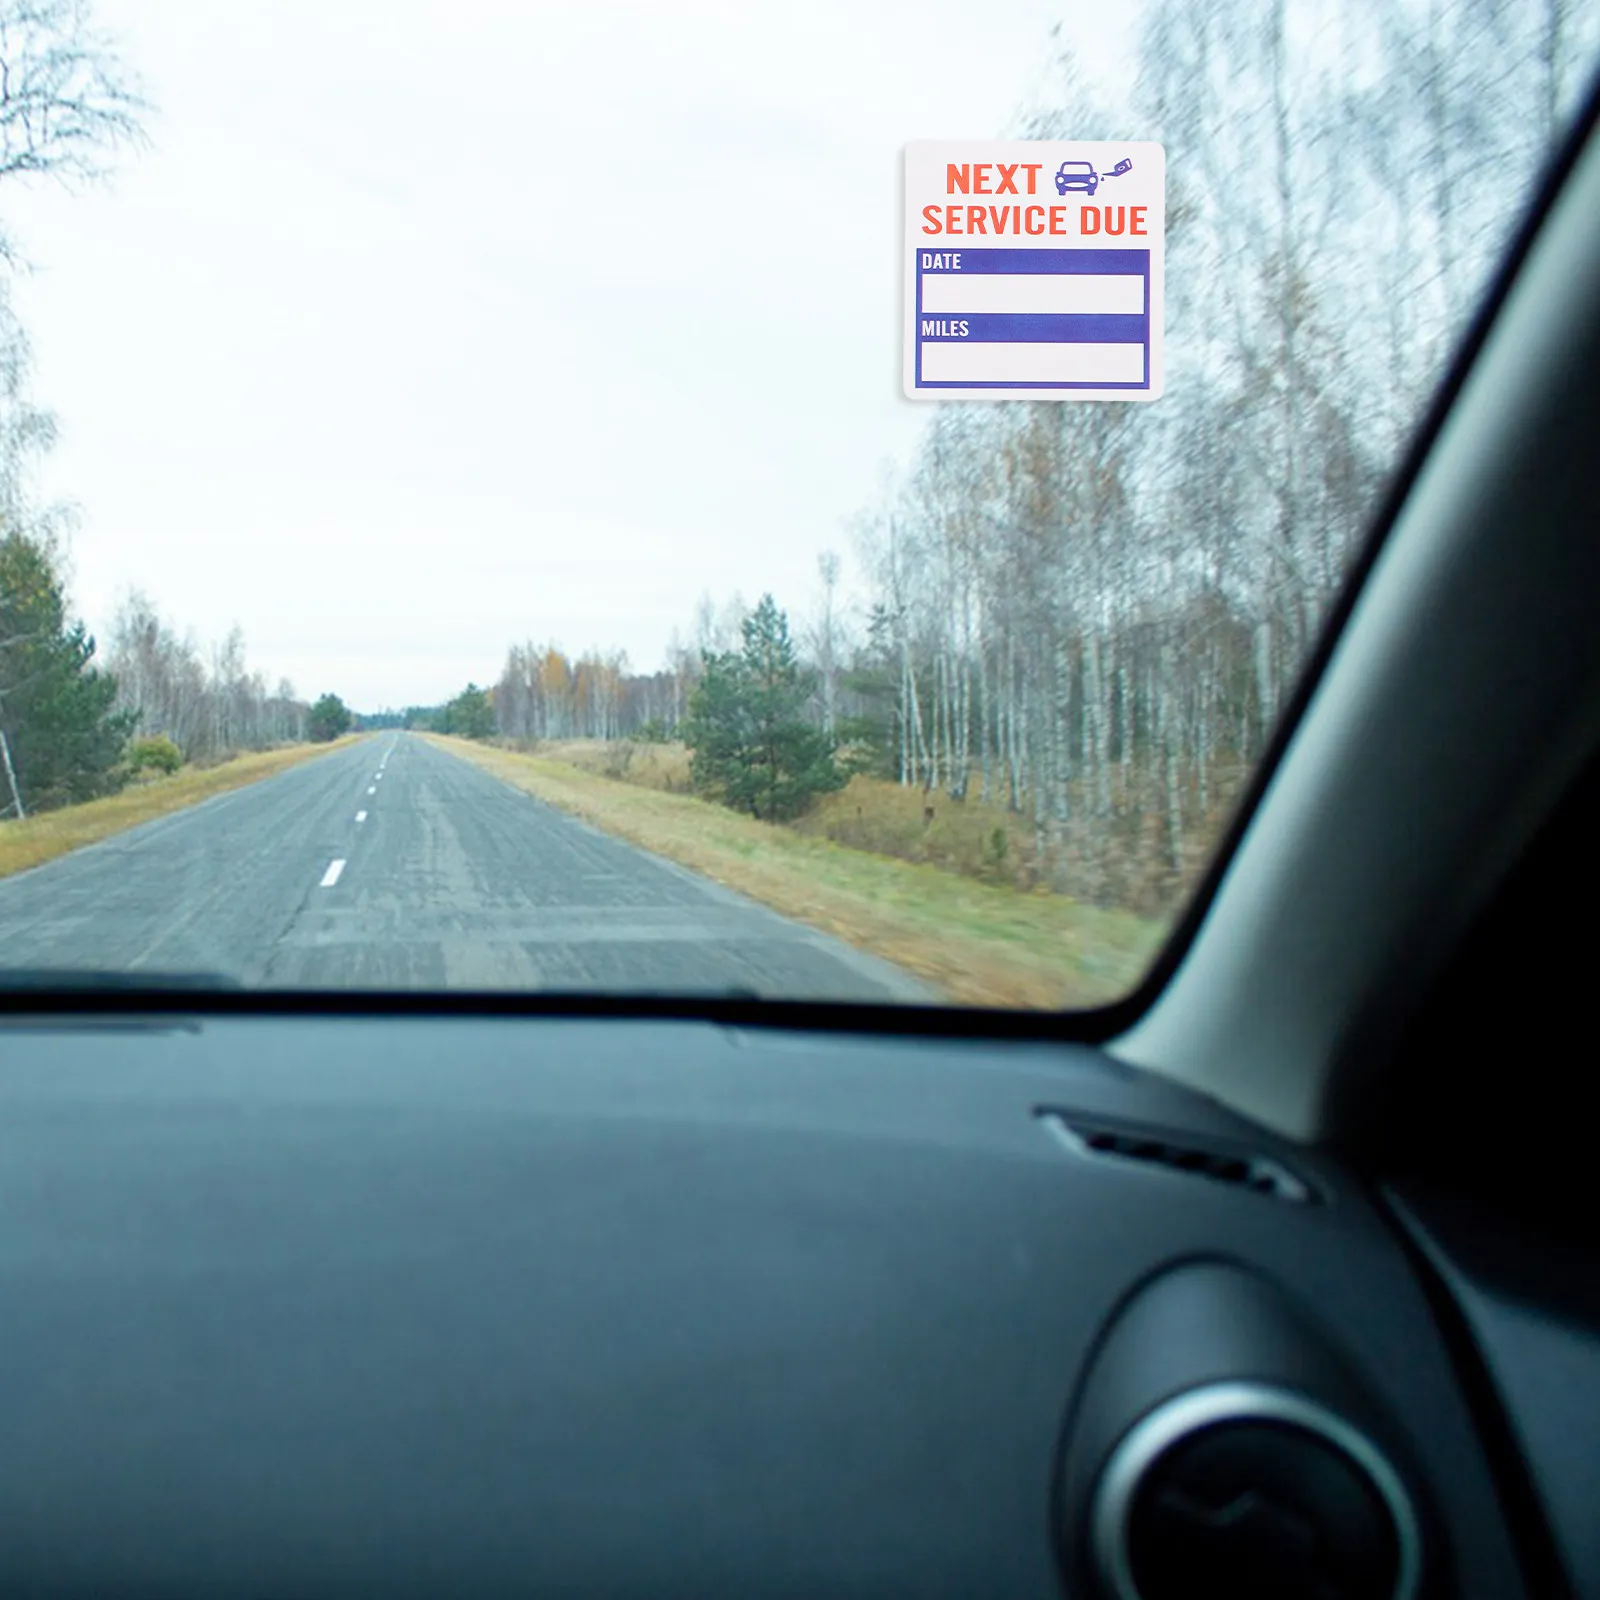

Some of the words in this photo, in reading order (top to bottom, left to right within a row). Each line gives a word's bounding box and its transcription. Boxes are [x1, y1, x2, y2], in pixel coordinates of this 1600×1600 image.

[946, 164, 1042, 194] NEXT
[921, 205, 1067, 235] SERVICE
[1080, 206, 1148, 236] DUE
[922, 253, 961, 269] DATE
[922, 320, 969, 337] MILES
